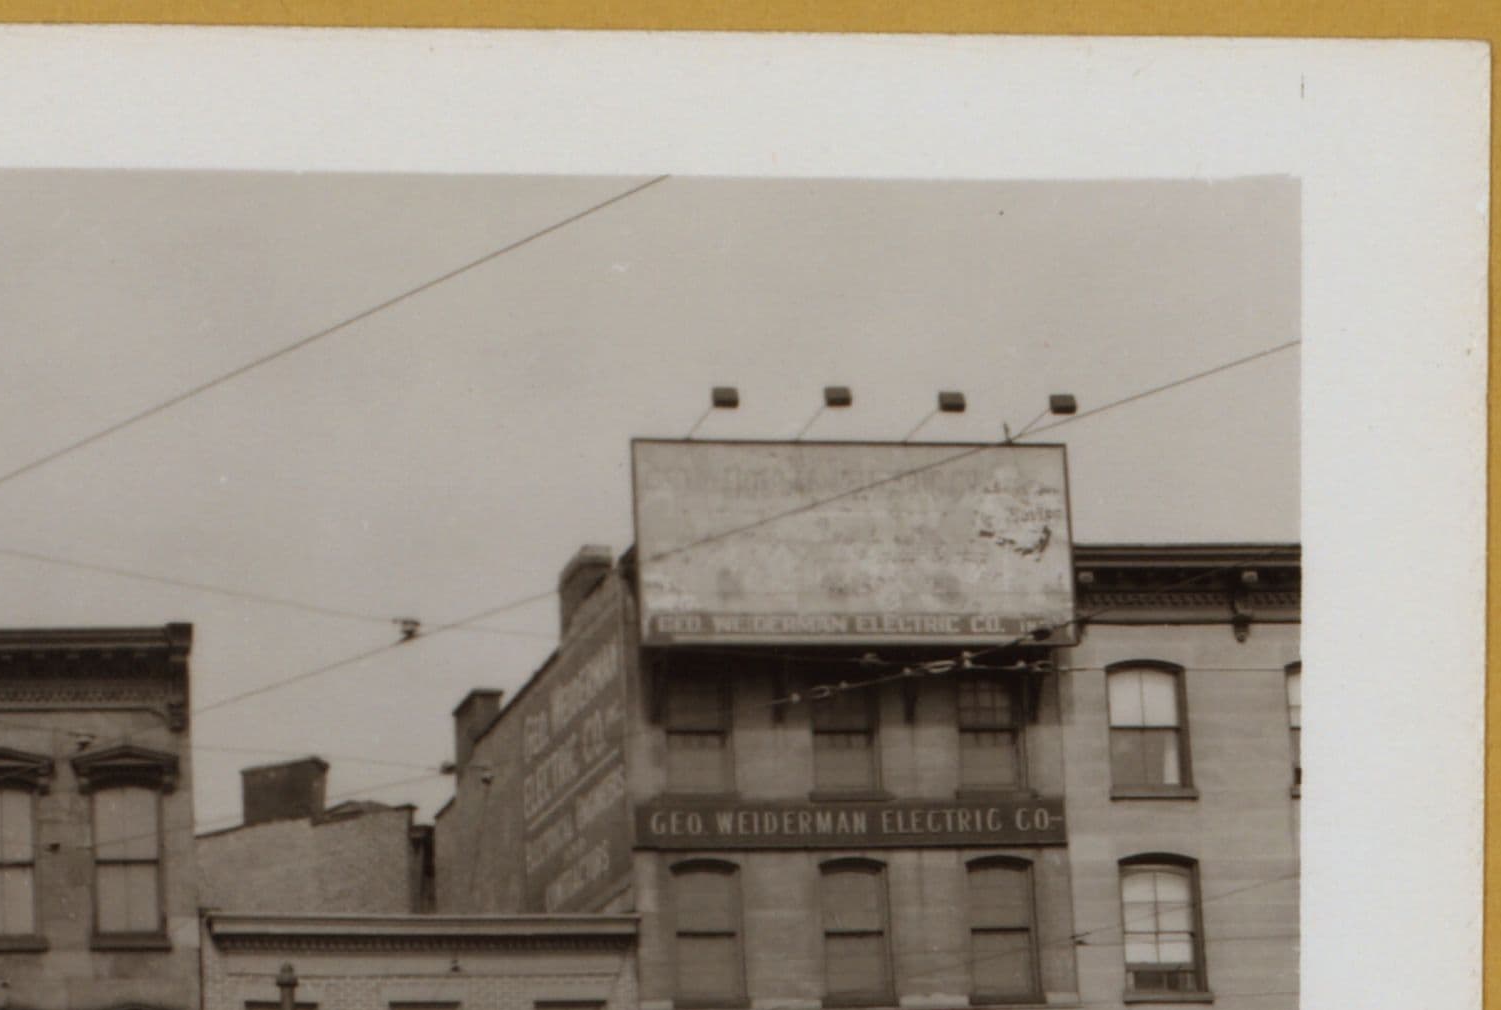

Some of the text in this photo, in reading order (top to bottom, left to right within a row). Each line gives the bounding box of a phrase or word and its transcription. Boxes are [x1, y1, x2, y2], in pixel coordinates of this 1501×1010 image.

[856, 612, 961, 634] ELECTRIC
[715, 810, 868, 836] WEIDERMAN
[882, 807, 1003, 834] ELECTRIC
